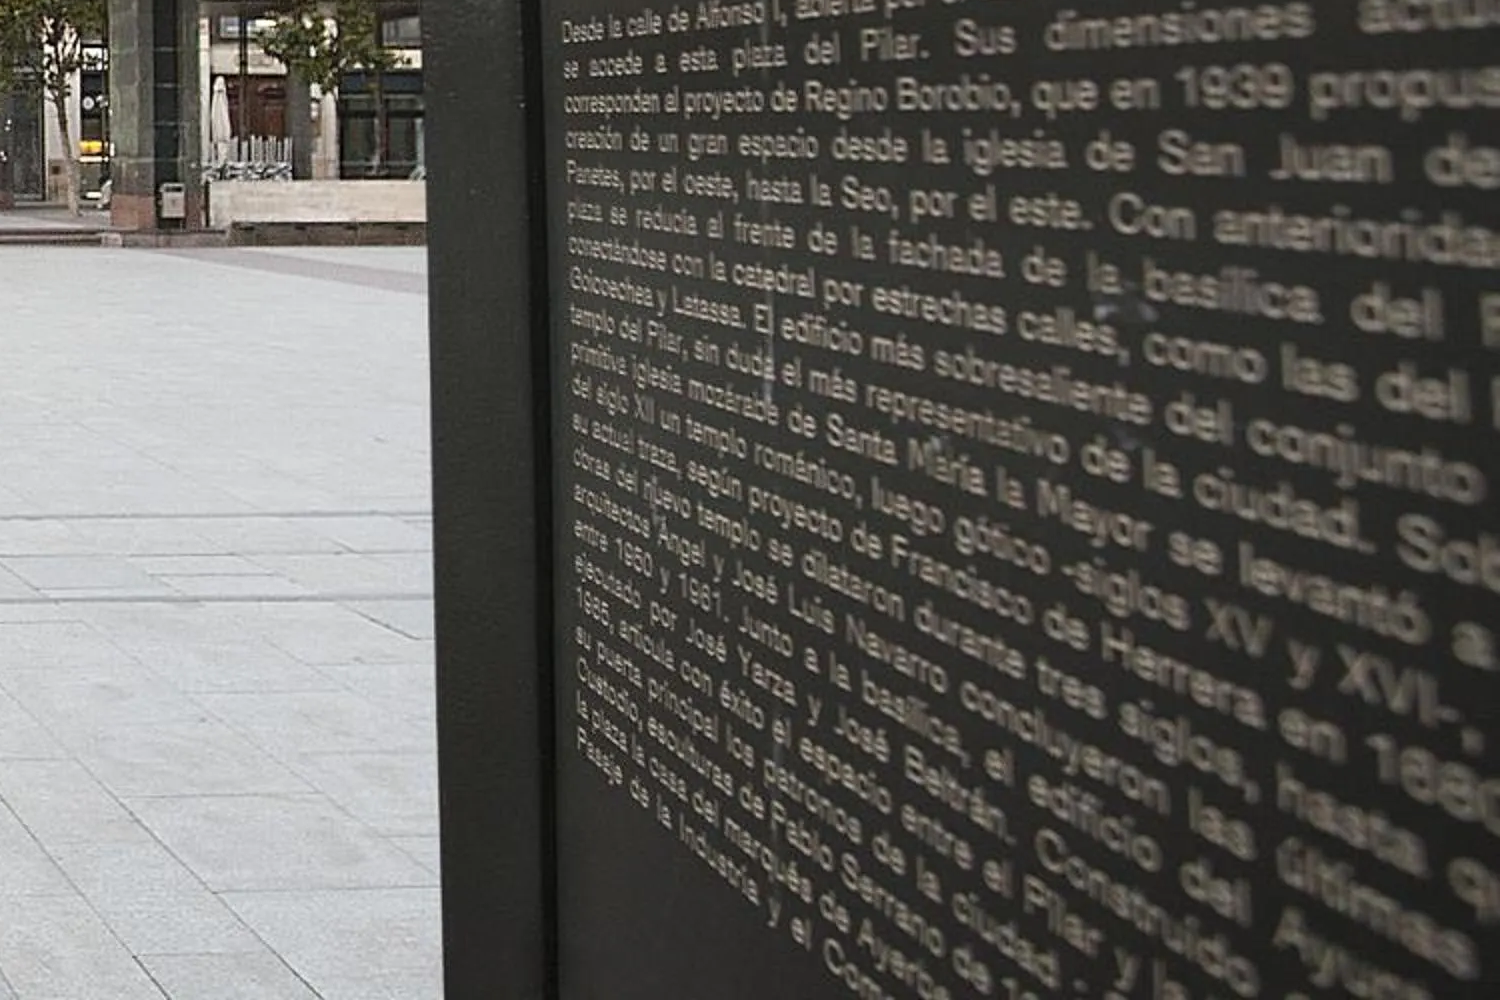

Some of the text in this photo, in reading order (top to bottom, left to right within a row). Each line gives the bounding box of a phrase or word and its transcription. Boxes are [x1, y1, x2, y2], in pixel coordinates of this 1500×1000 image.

[561, 16, 604, 43] Desde
[627, 8, 662, 37] calle
[696, 0, 765, 29] Alfonso
[564, 88, 660, 119] corresponden
[685, 88, 764, 120] proyecto
[805, 79, 887, 120] Regino
[897, 74, 1021, 117] Borobio,
[1033, 80, 1098, 119] que
[1110, 79, 1159, 110] en
[1176, 64, 1292, 108] 1939
[589, 50, 642, 77] accede
[679, 47, 718, 72] esta
[732, 33, 787, 77] plaza
[804, 34, 839, 64] del
[861, 28, 929, 60] Pilar.
[956, 19, 1015, 56] Sus
[1045, 2, 1312, 50] dimensiones
[566, 159, 624, 193] Panetes,
[630, 170, 656, 195] por
[683, 172, 738, 203] oeste,
[747, 171, 803, 203] hasta
[842, 176, 898, 219] Seo,
[910, 190, 957, 223] por
[969, 185, 996, 220] el
[1010, 194, 1092, 229] este.
[1110, 193, 1195, 238] Con
[688, 133, 727, 161] gran
[739, 127, 818, 164] espacio
[832, 128, 907, 162] desde
[924, 131, 950, 163] la
[963, 129, 1067, 175] iglesia
[1086, 132, 1134, 171] de
[1158, 130, 1243, 175] San
[1269, 138, 1391, 182] Juan
[566, 197, 603, 225] plaza
[733, 213, 795, 248] frente
[853, 227, 876, 260] la
[888, 230, 1005, 277] fachada
[1023, 247, 1066, 286] de
[1089, 254, 1123, 294] la
[1351, 283, 1442, 337] del
[672, 254, 703, 277] con
[733, 264, 815, 297] catedral
[823, 279, 864, 309] por
[872, 287, 1006, 334] estrechas
[1019, 306, 1129, 364] calles,
[1144, 333, 1265, 383] como
[1282, 345, 1358, 401] las
[1377, 364, 1470, 421] del
[568, 265, 1483, 504] Goicoechea Latassa. edificio más sobresaliente del conjunto
[568, 302, 1374, 552] templo del Pilar, sin duda más representativo de la ciudad.
[596, 382, 629, 416] siglo
[686, 414, 746, 458] templo
[872, 477, 943, 535] luego
[632, 354, 682, 394] iglesia
[827, 413, 898, 465] Santa
[998, 468, 1026, 509] la
[1038, 479, 1152, 548] Mayor
[1170, 532, 1221, 574] se
[592, 421, 632, 453] actual
[638, 437, 681, 480] traza,
[749, 486, 842, 542] proyecto
[892, 534, 1031, 624] Francisco
[1102, 623, 1266, 728] Herrera
[574, 519, 608, 552] entre
[739, 607, 792, 657] Junto
[1029, 776, 1160, 871] edificio
[592, 709, 628, 753] plaza
[697, 502, 759, 551] templo
[803, 550, 904, 620] dilataron
[915, 602, 1025, 678] durante
[1120, 700, 1258, 802] siglos,
[1278, 764, 1427, 876] hasta
[738, 645, 797, 706] Yarza
[905, 745, 1015, 842] Beltrán.
[847, 614, 947, 693] Navarro
[961, 682, 1168, 812] concluyeron
[597, 640, 642, 688] puerta
[648, 678, 718, 742] principal
[954, 893, 1060, 988] ciudad
[771, 800, 833, 871] Pablo
[842, 853, 944, 957] Serrano
[800, 738, 891, 814] espacio
[902, 805, 972, 869] entre
[1024, 875, 1102, 955] Pilar
